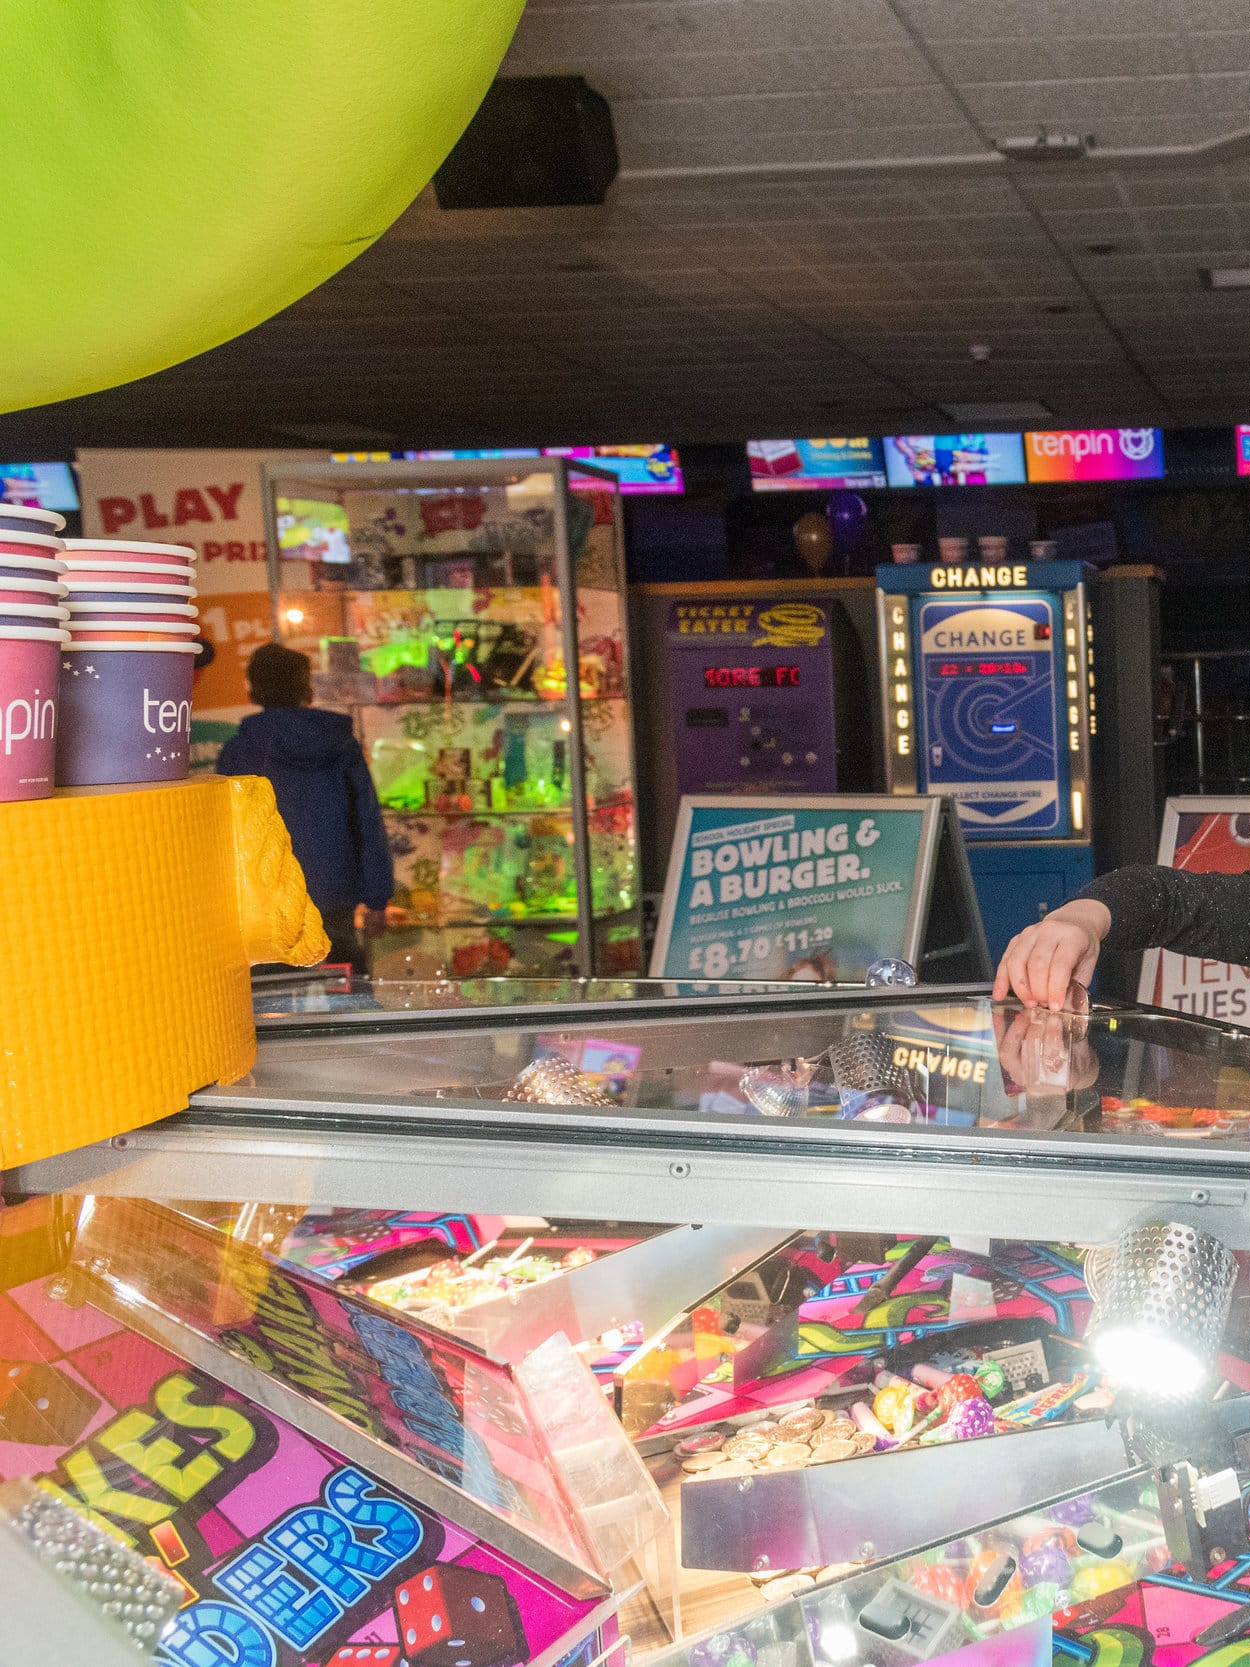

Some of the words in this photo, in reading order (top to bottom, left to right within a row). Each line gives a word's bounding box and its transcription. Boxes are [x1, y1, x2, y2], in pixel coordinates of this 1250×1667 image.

[1033, 430, 1114, 462] tenpin
[98, 483, 244, 534] PLAY
[931, 566, 1028, 588] CHANGE
[679, 619, 748, 634] EATER
[934, 630, 1027, 648] CHANGE
[892, 606, 911, 755] CHANGE
[0, 689, 55, 755] pin
[691, 823, 848, 877] BOWLING
[856, 819, 881, 847] &
[689, 879, 713, 909] A
[720, 853, 870, 904] BURGER.
[688, 937, 771, 980] £8.70
[34, 1373, 256, 1548] KES
[150, 1466, 424, 1667] DERS
